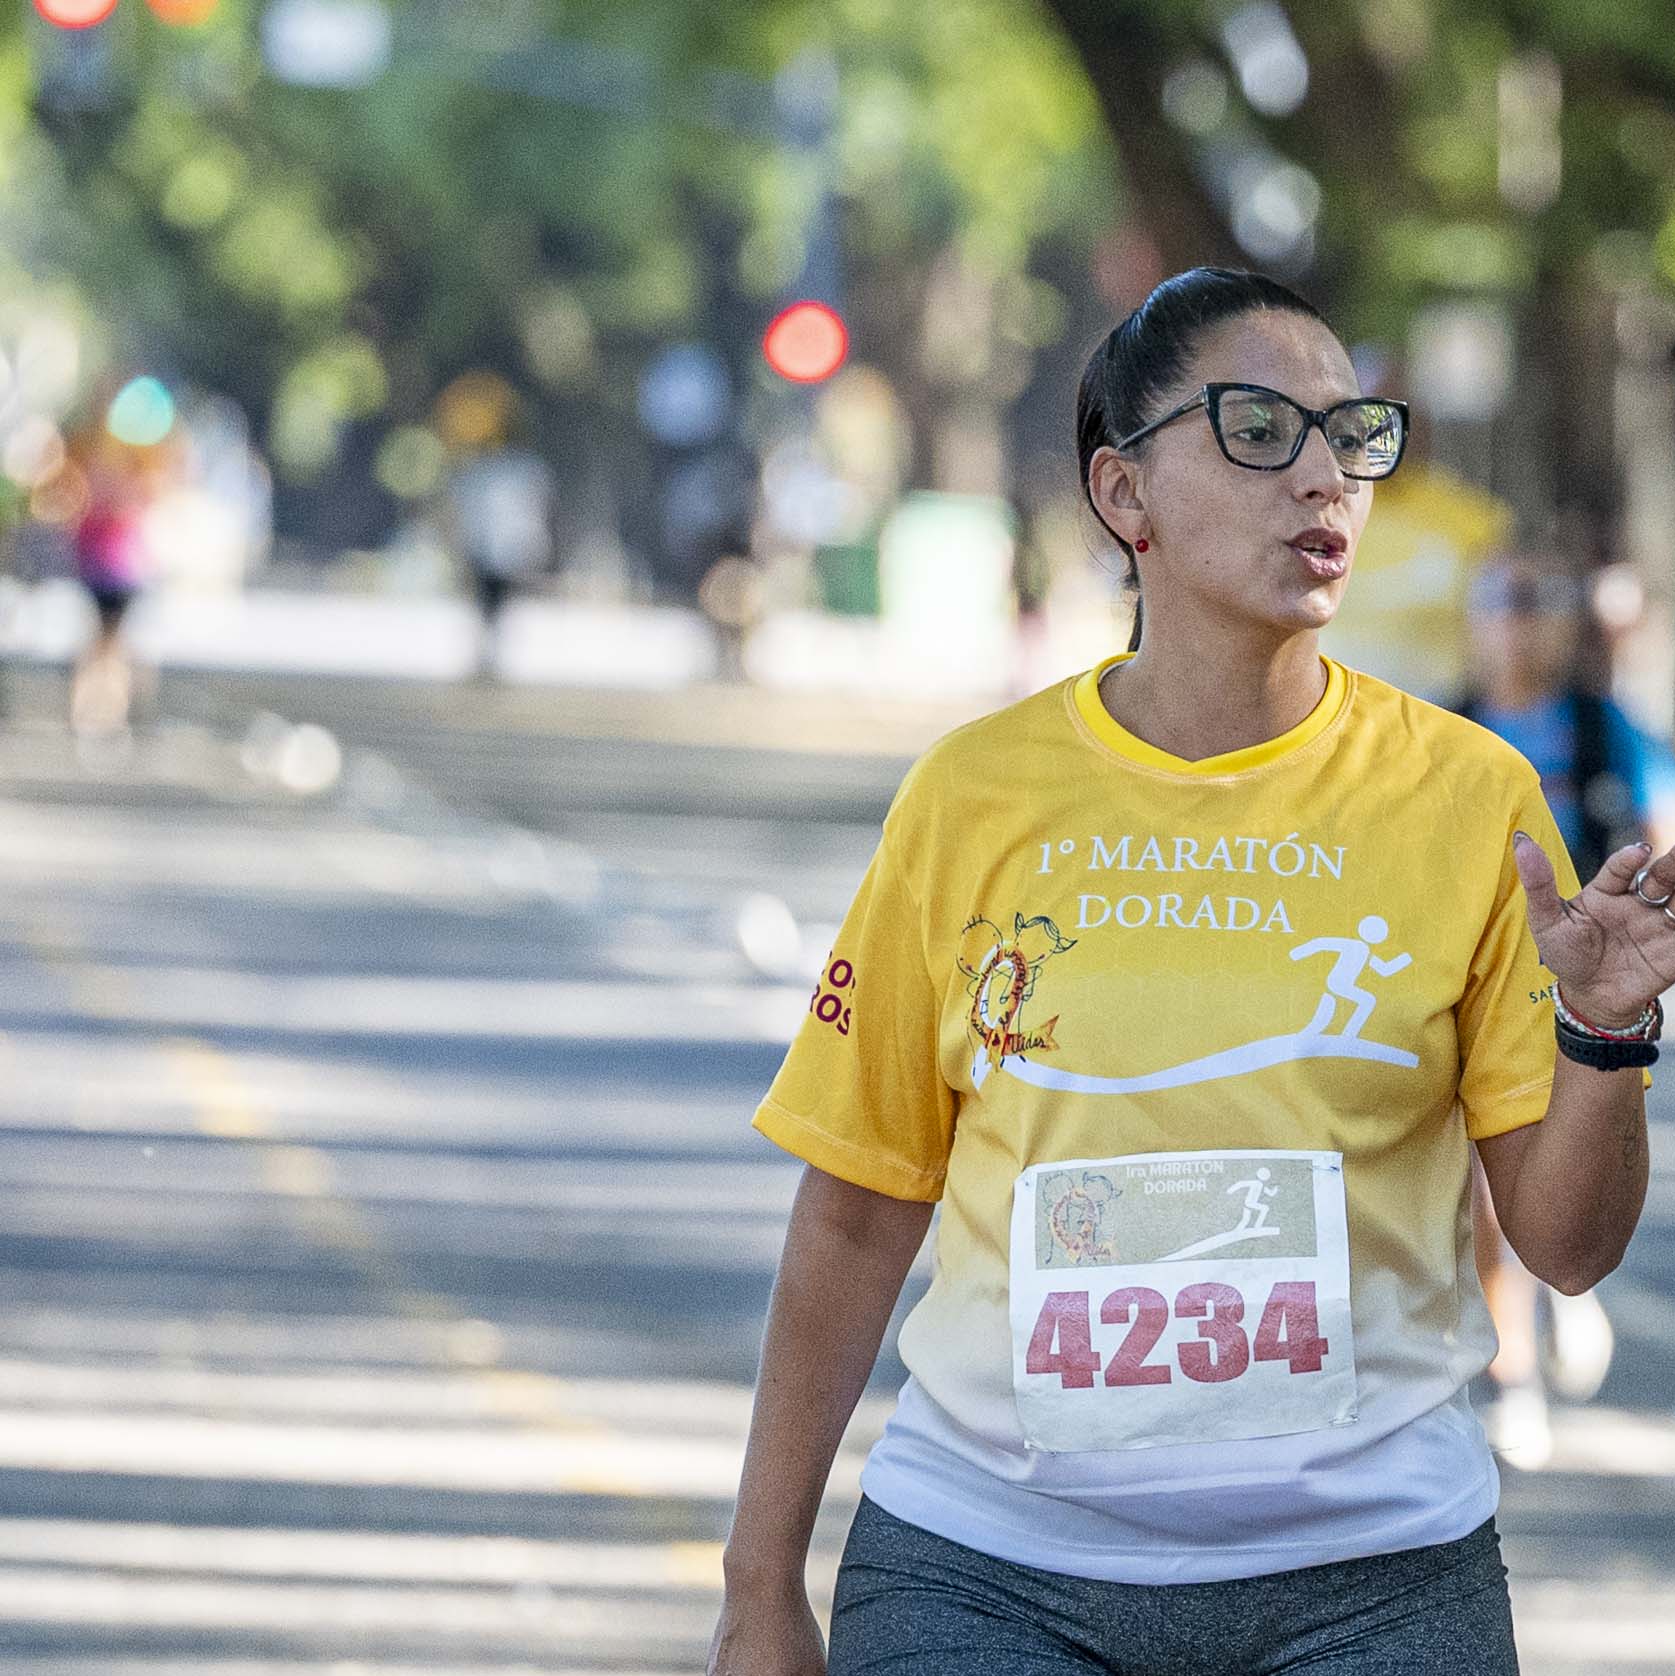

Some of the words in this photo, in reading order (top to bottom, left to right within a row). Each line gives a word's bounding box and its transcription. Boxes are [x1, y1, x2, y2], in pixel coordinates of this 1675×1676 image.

[1087, 831, 1348, 881] MARATÓN
[1075, 893, 1295, 934] DORADA
[1143, 1178, 1207, 1195] DORADA
[1026, 1280, 1329, 1390] 4234
